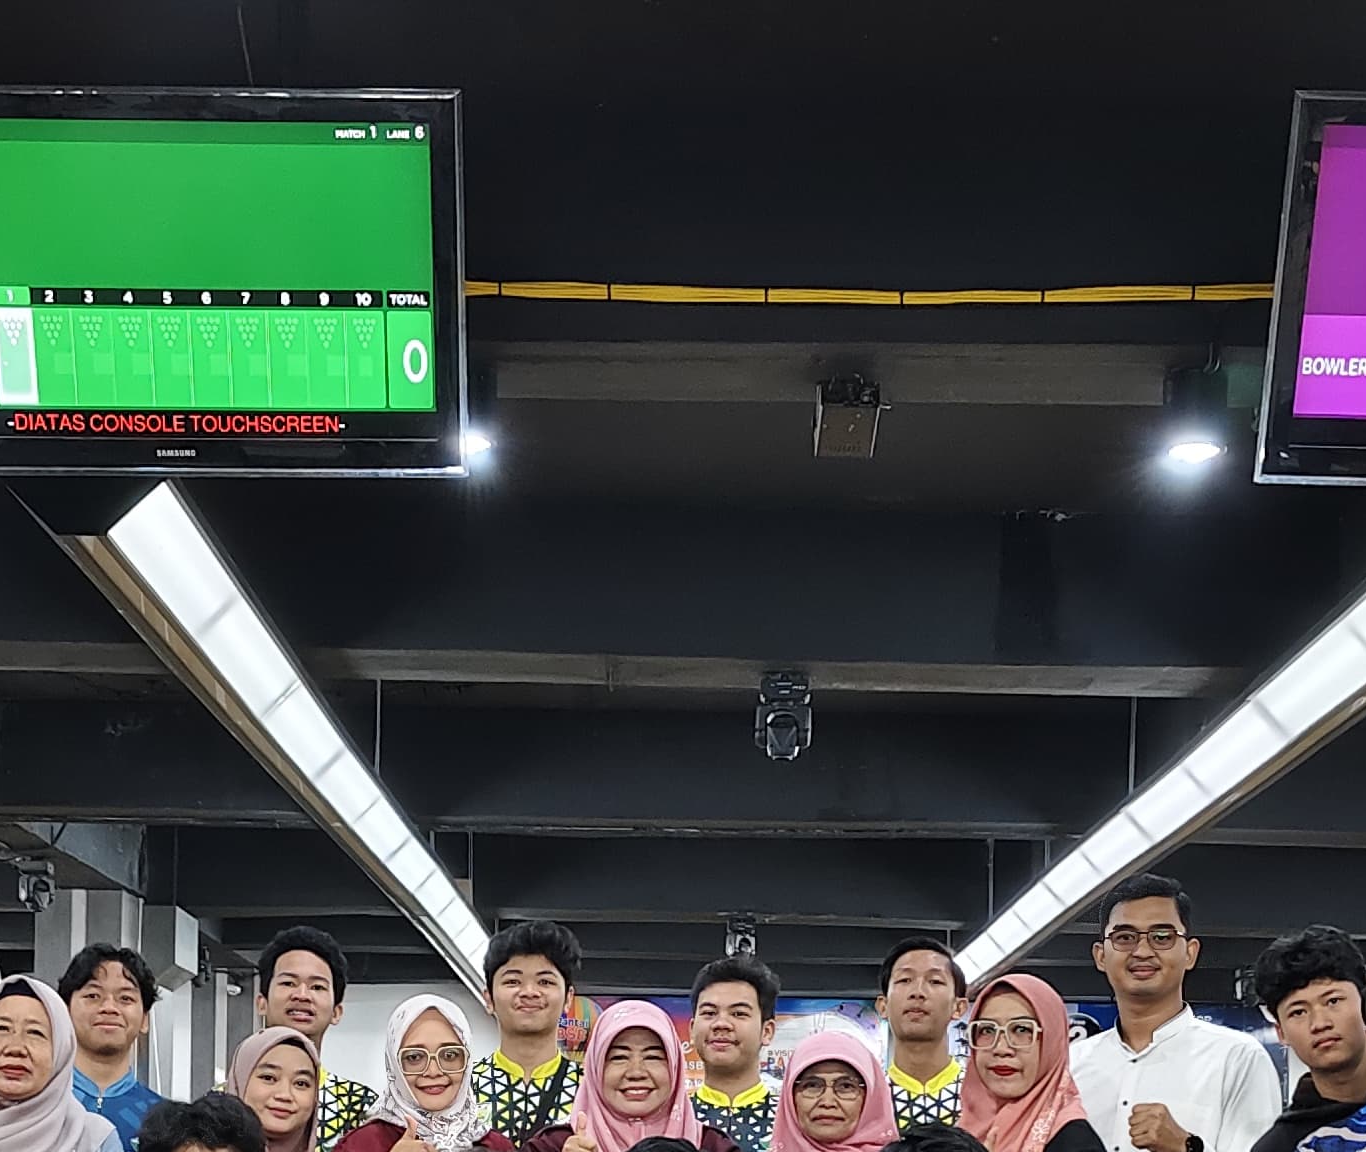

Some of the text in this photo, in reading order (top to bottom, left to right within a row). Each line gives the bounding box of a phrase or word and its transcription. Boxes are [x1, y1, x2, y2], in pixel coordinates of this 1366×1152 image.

[335, 125, 425, 140] MATCH 1 LANE 6
[6, 290, 427, 306] 1 2 3 4 5 6 7 8 9 10 TOTAL
[402, 339, 428, 384] 0
[89, 414, 185, 433] CONSOLE
[156, 449, 196, 458] SAMSUNG
